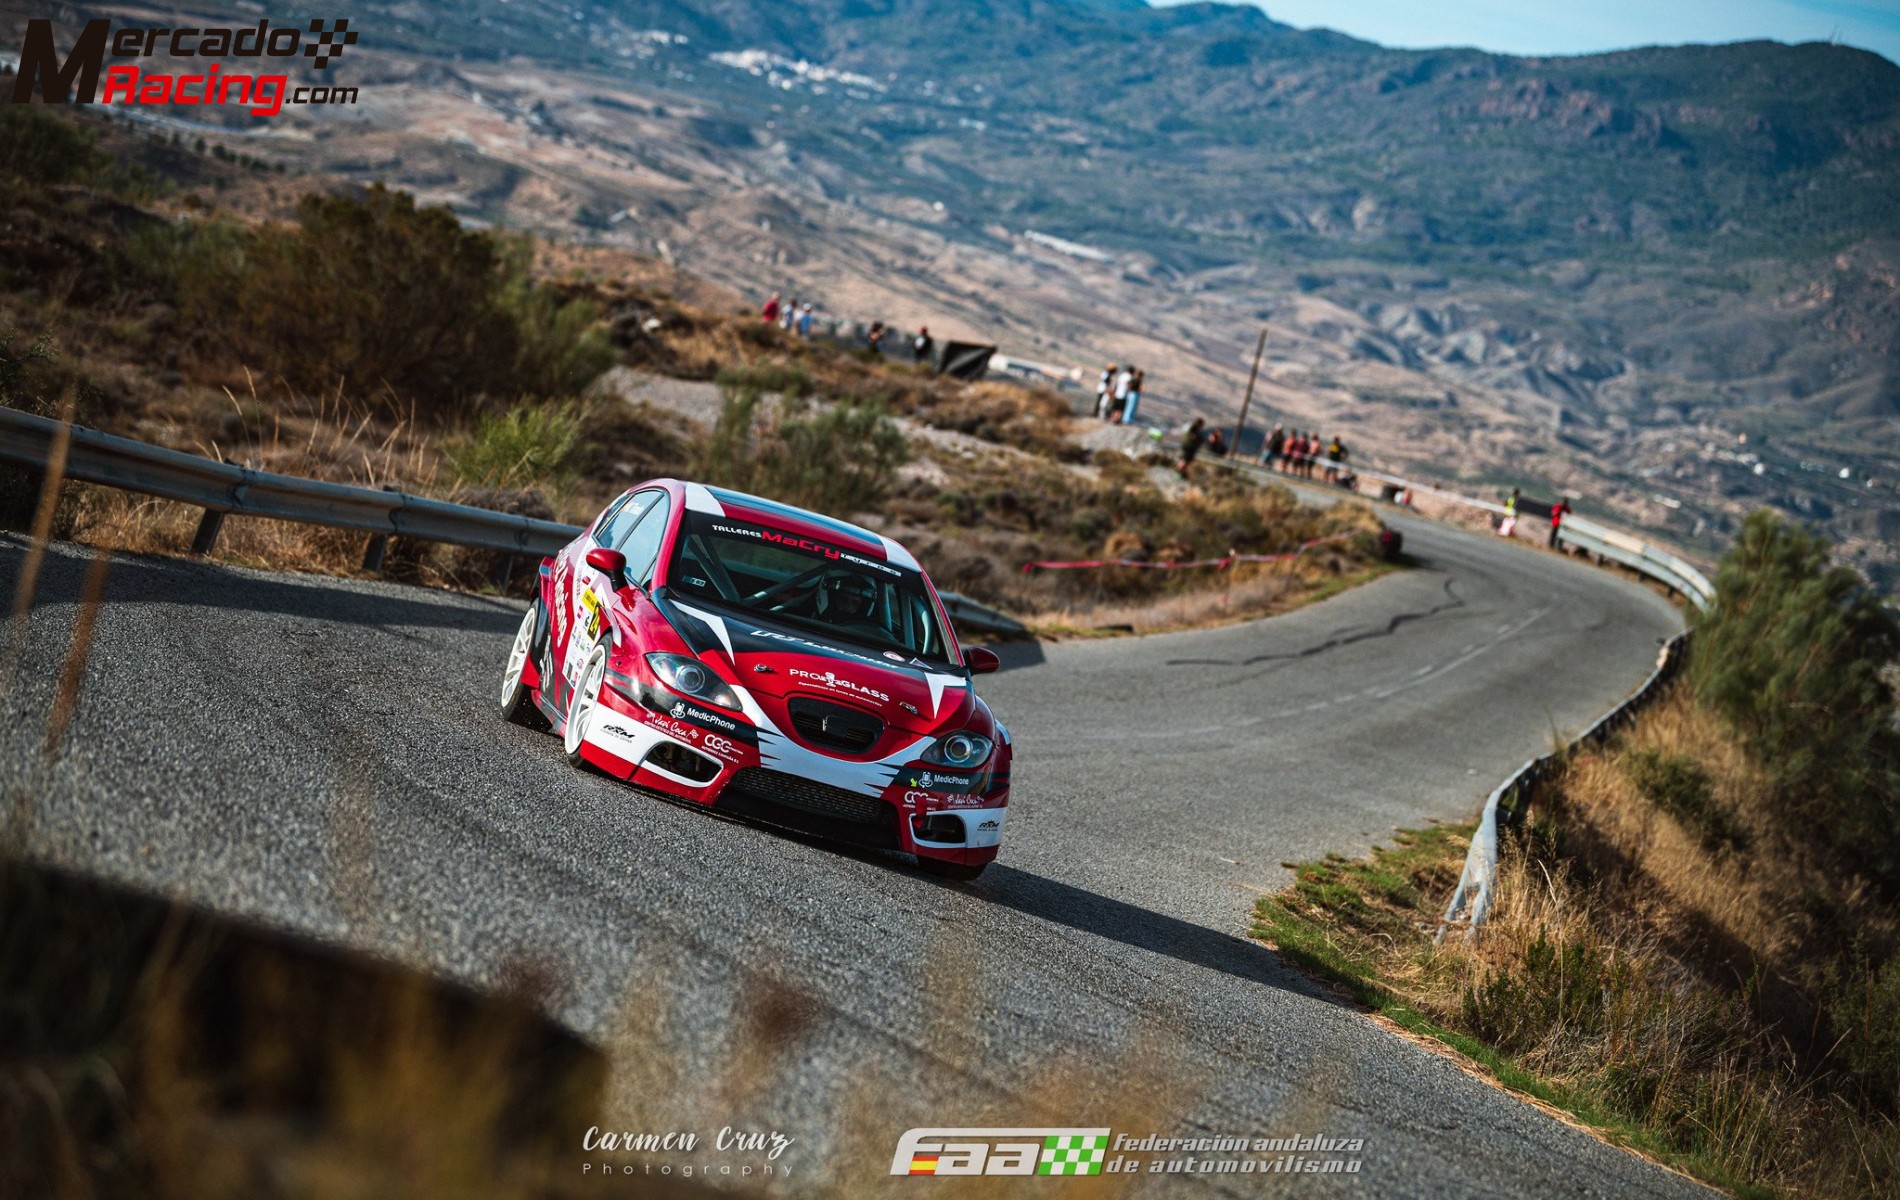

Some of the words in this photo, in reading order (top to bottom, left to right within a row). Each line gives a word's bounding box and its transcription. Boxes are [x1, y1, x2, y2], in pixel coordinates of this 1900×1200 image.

[712, 524, 762, 538] TALLERES
[839, 680, 889, 702] GLASS
[687, 707, 735, 730] MedicPhone
[934, 774, 969, 785] MedicPhone
